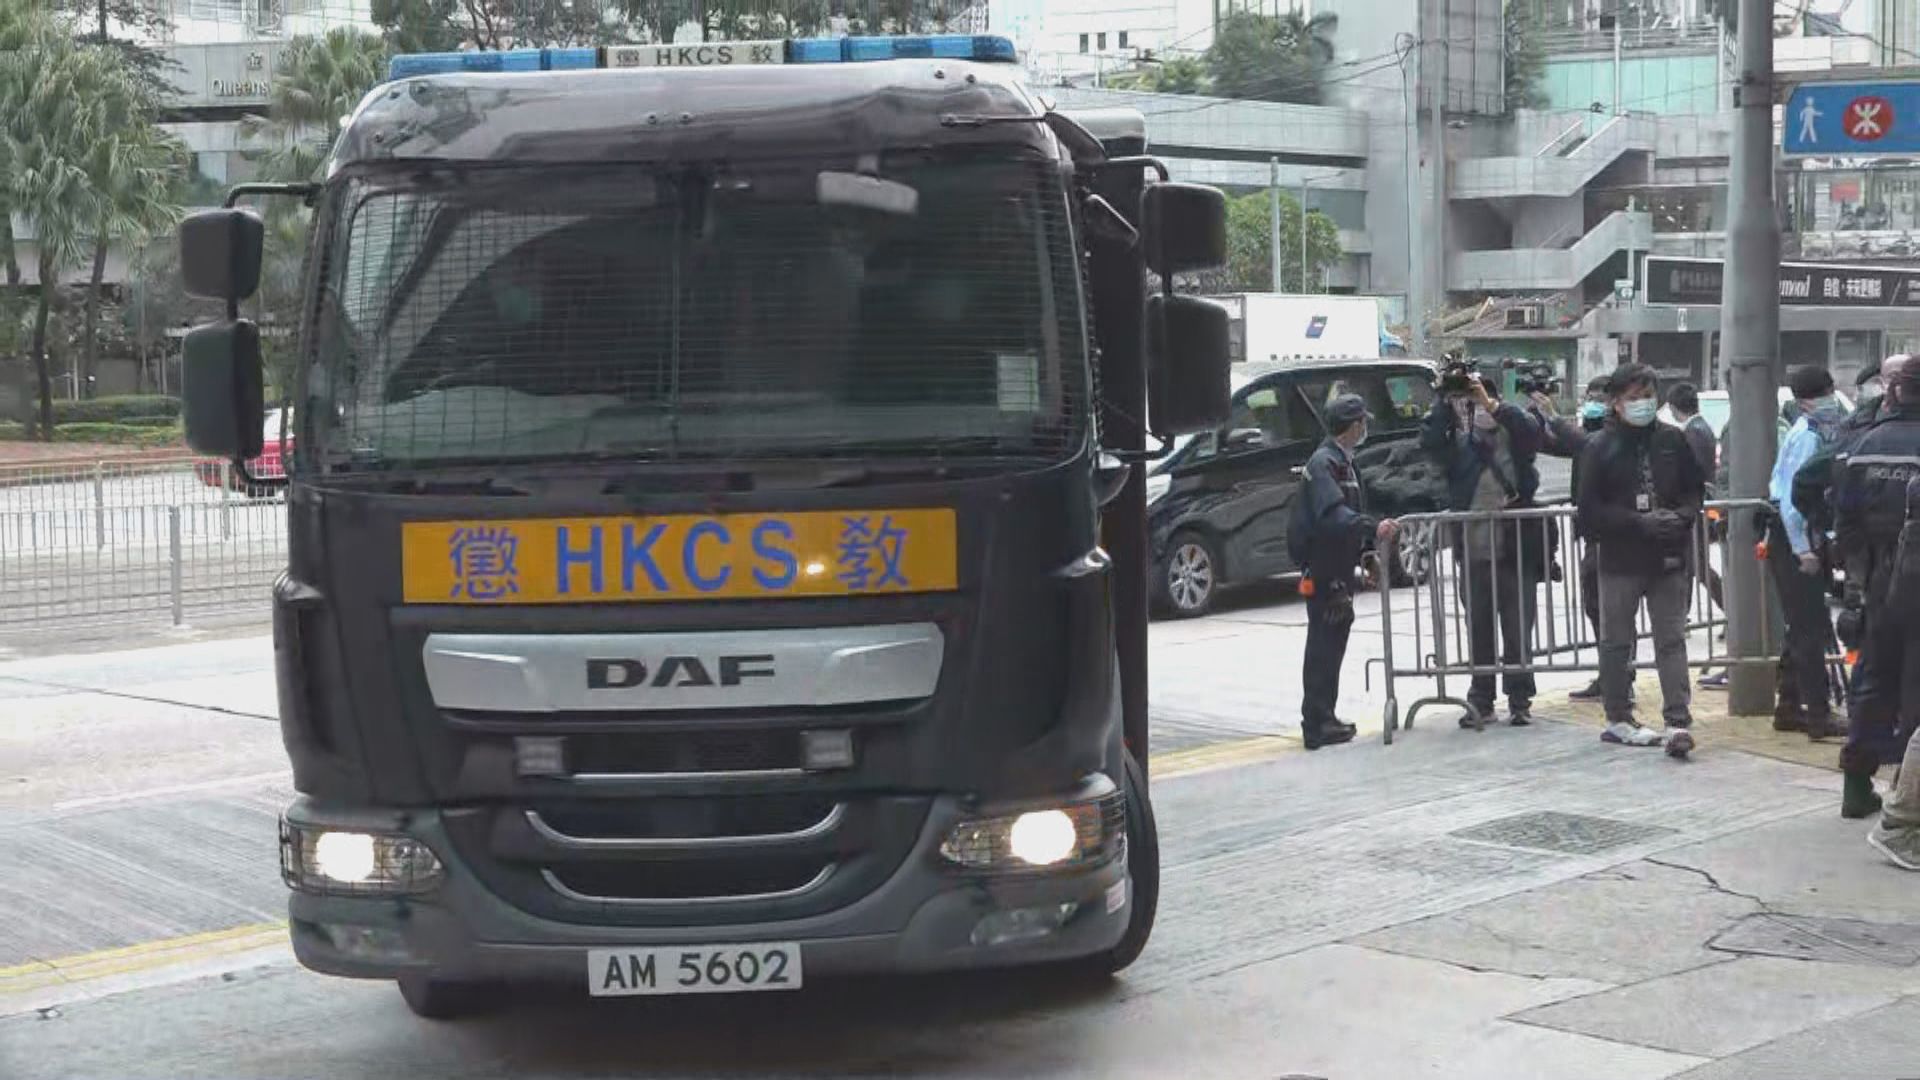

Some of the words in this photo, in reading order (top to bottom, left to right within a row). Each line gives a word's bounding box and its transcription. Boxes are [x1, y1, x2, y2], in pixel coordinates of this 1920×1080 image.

[656, 46, 733, 65] HKCS
[449, 526, 521, 600] 懲
[556, 520, 798, 594] HKCS
[586, 654, 776, 690] DAF
[603, 954, 657, 988] AM
[678, 950, 789, 986] 5602
